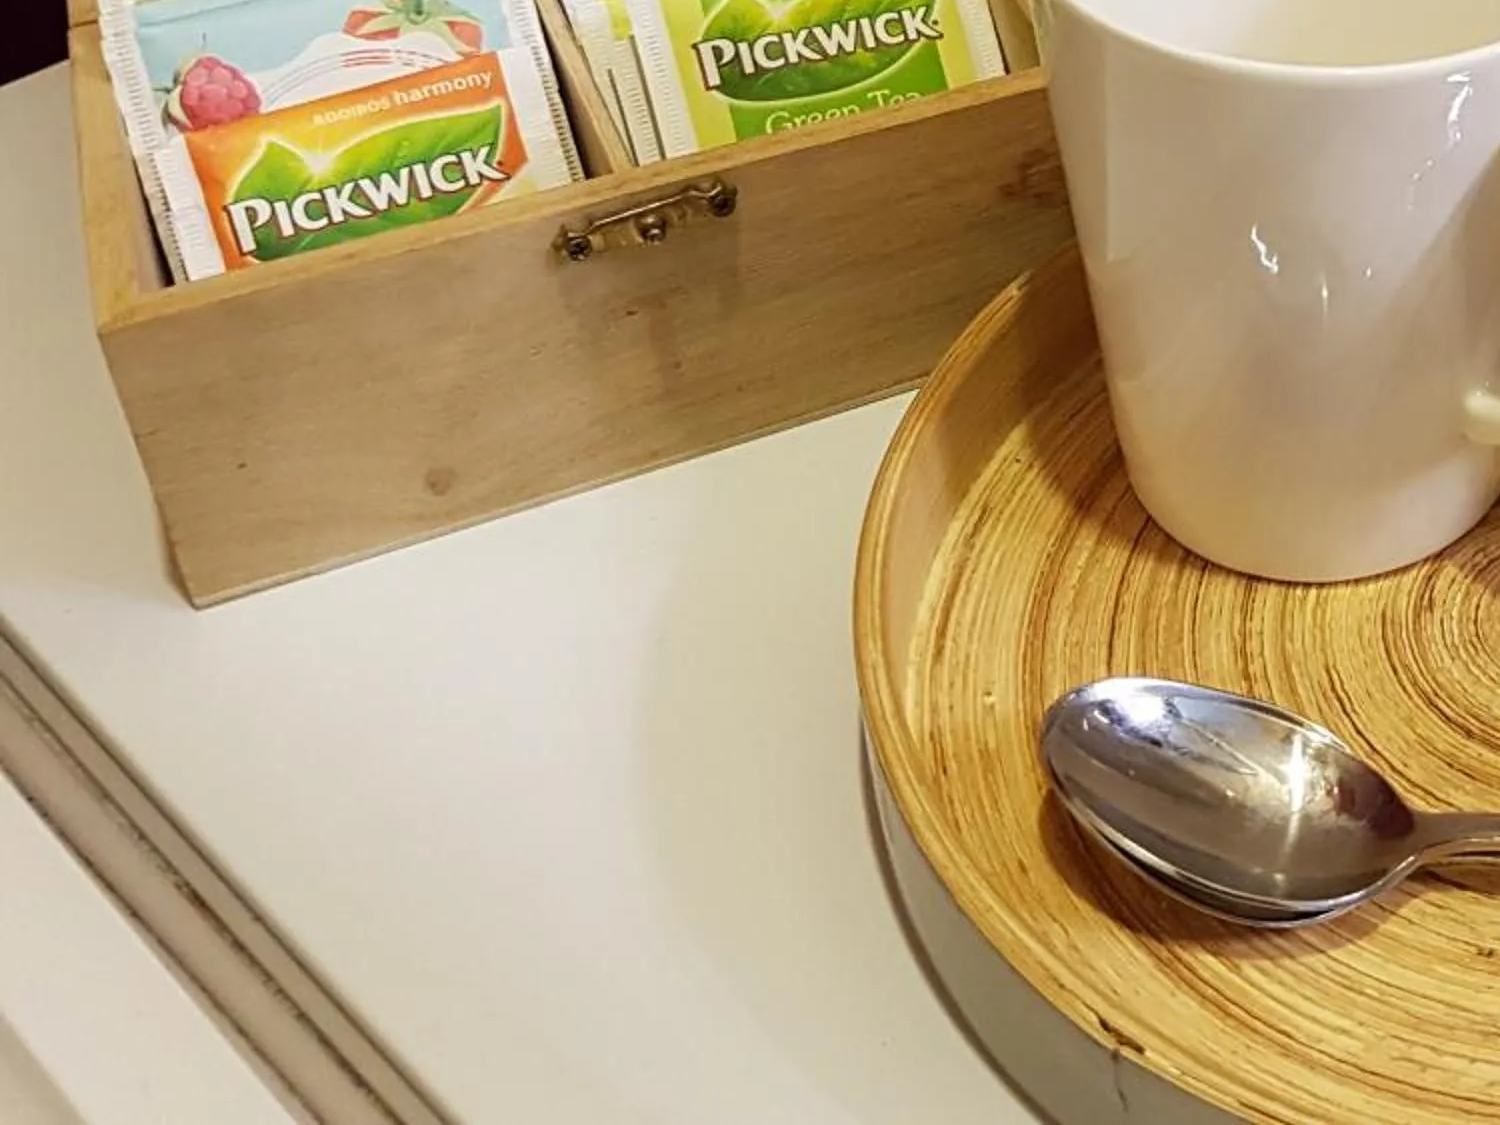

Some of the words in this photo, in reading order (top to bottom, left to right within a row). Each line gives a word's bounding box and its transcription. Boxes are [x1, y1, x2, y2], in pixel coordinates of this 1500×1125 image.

[392, 70, 494, 108] harmony
[691, 4, 944, 91] PICKWICK
[224, 142, 511, 255] PICKWICK
